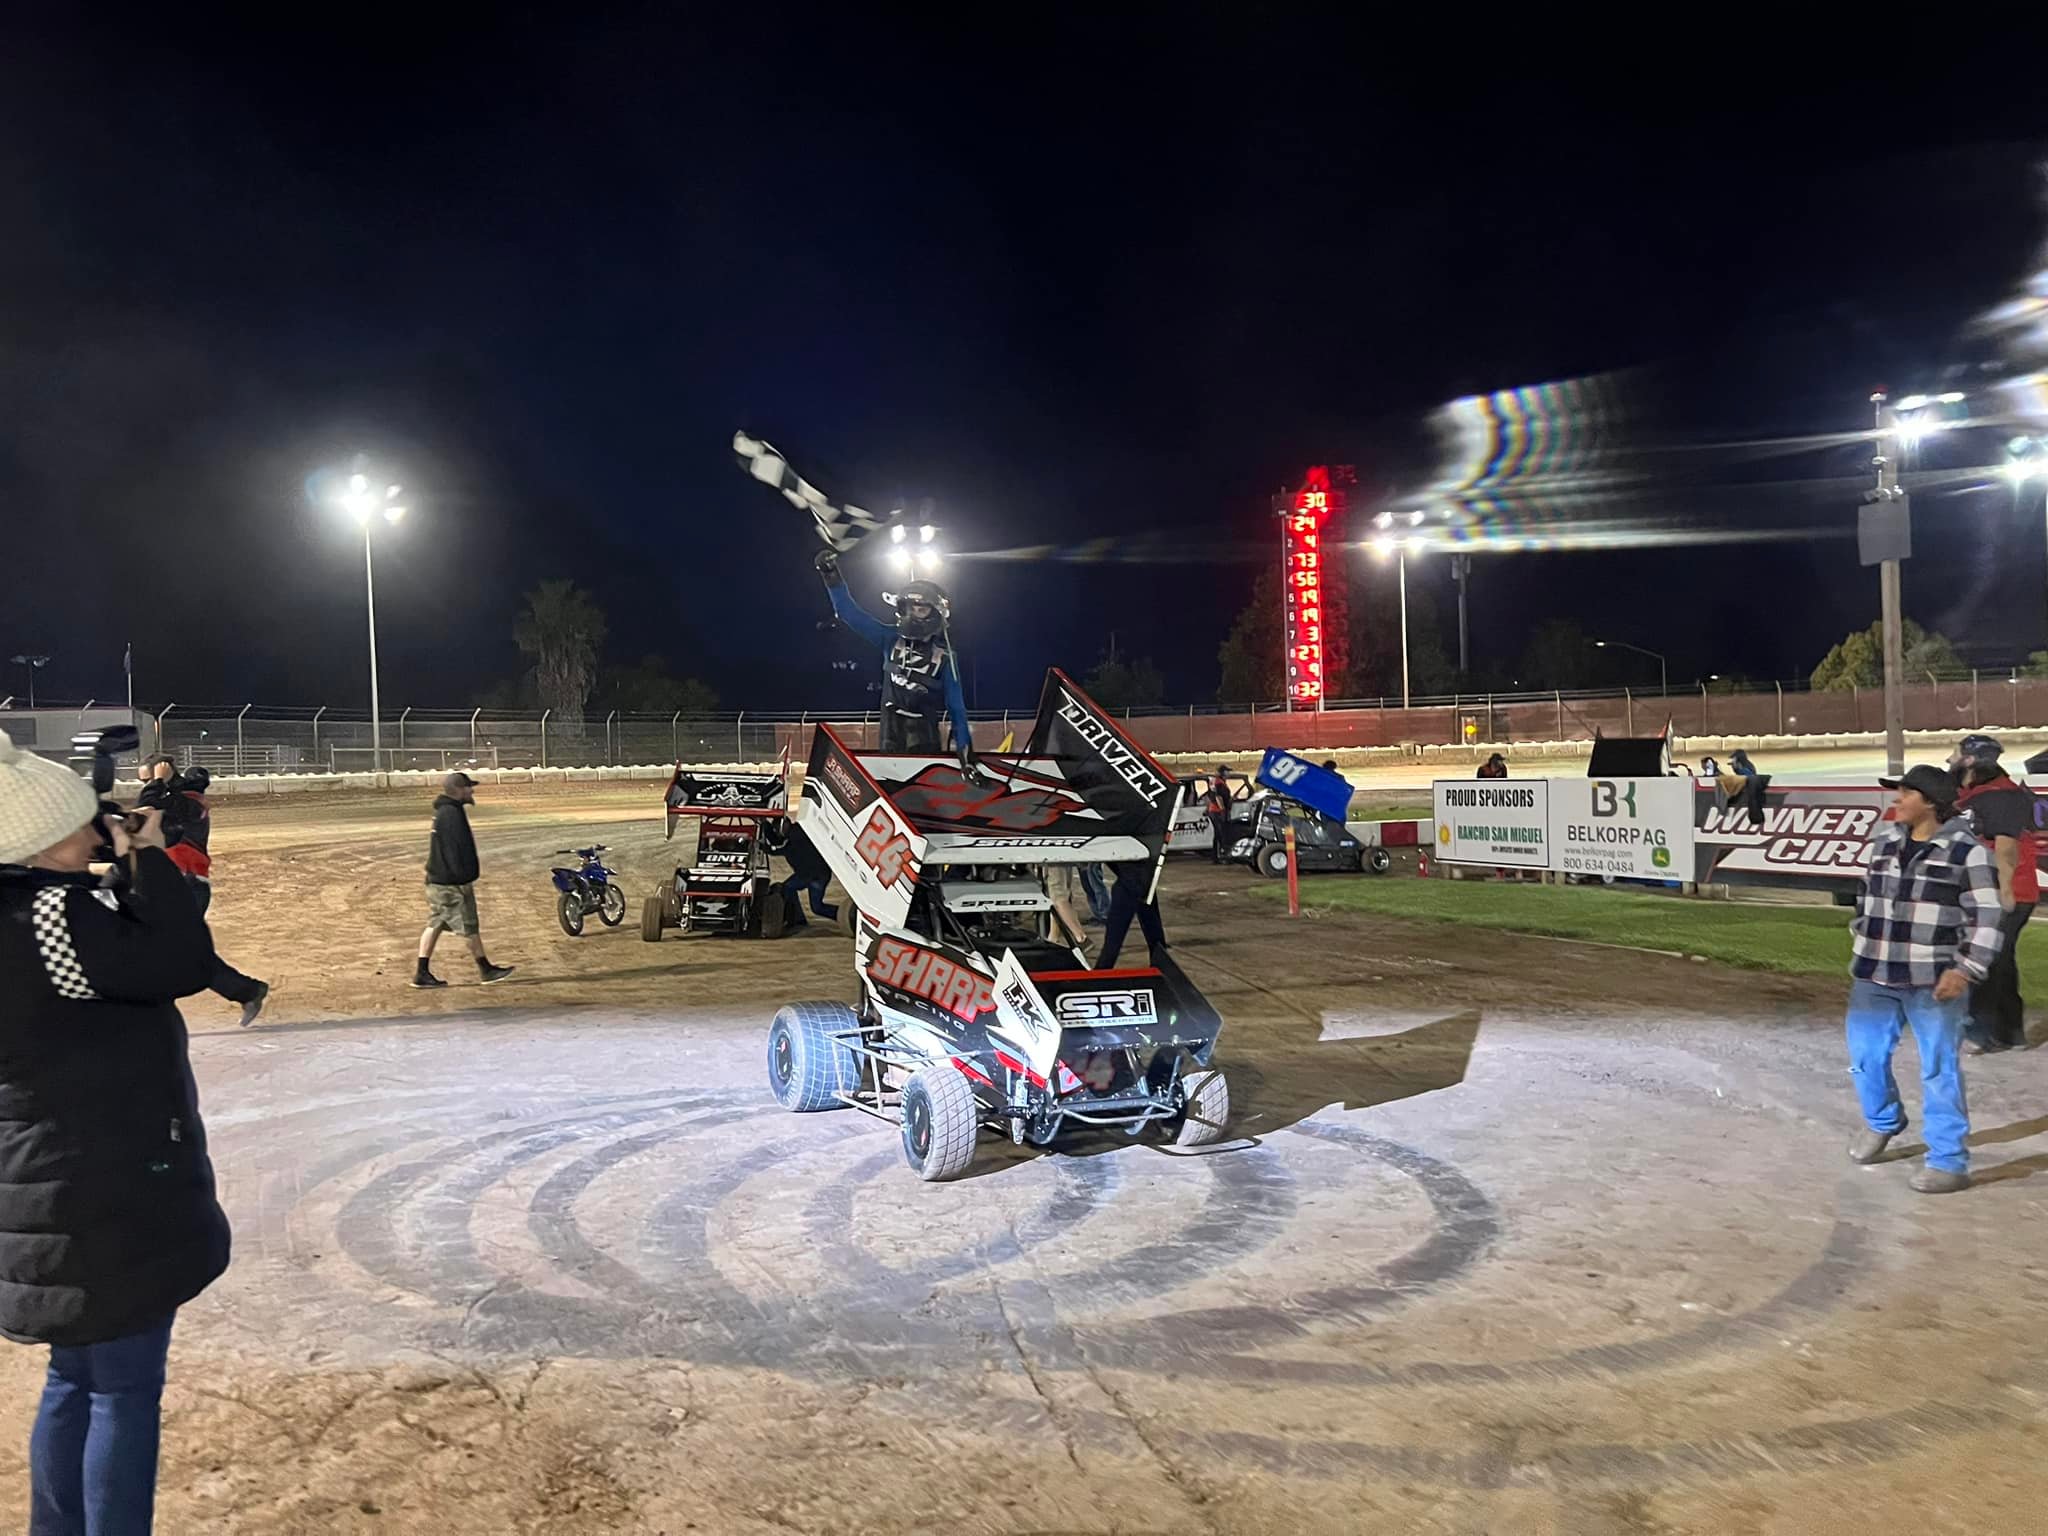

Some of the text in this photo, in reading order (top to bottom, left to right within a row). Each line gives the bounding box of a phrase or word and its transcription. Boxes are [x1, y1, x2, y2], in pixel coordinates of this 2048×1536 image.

[1304, 491, 1326, 509] 30
[1294, 515, 1316, 532] 24
[1287, 534, 1317, 548] 2 4
[1295, 552, 1317, 568] 73
[1295, 570, 1318, 587] 56
[1288, 592, 1295, 603] 5
[1288, 611, 1295, 622] 6
[1289, 625, 1319, 642] 7 3
[1290, 644, 1319, 661] 8 27
[1290, 662, 1320, 678] 9 9
[1288, 681, 1320, 697] 10 32
[835, 764, 862, 798] SHARP
[696, 787, 762, 803] UWS
[892, 765, 1080, 831] 24
[1446, 789, 1535, 808] PROUD SPONSORS
[1457, 825, 1544, 844] RANCHO SAN MIGUEL
[1567, 824, 1667, 846] BELKORP AG
[854, 805, 915, 890] 24
[961, 899, 1038, 908] SPEED
[867, 937, 998, 1024] SHARP
[877, 984, 966, 1032] RACING
